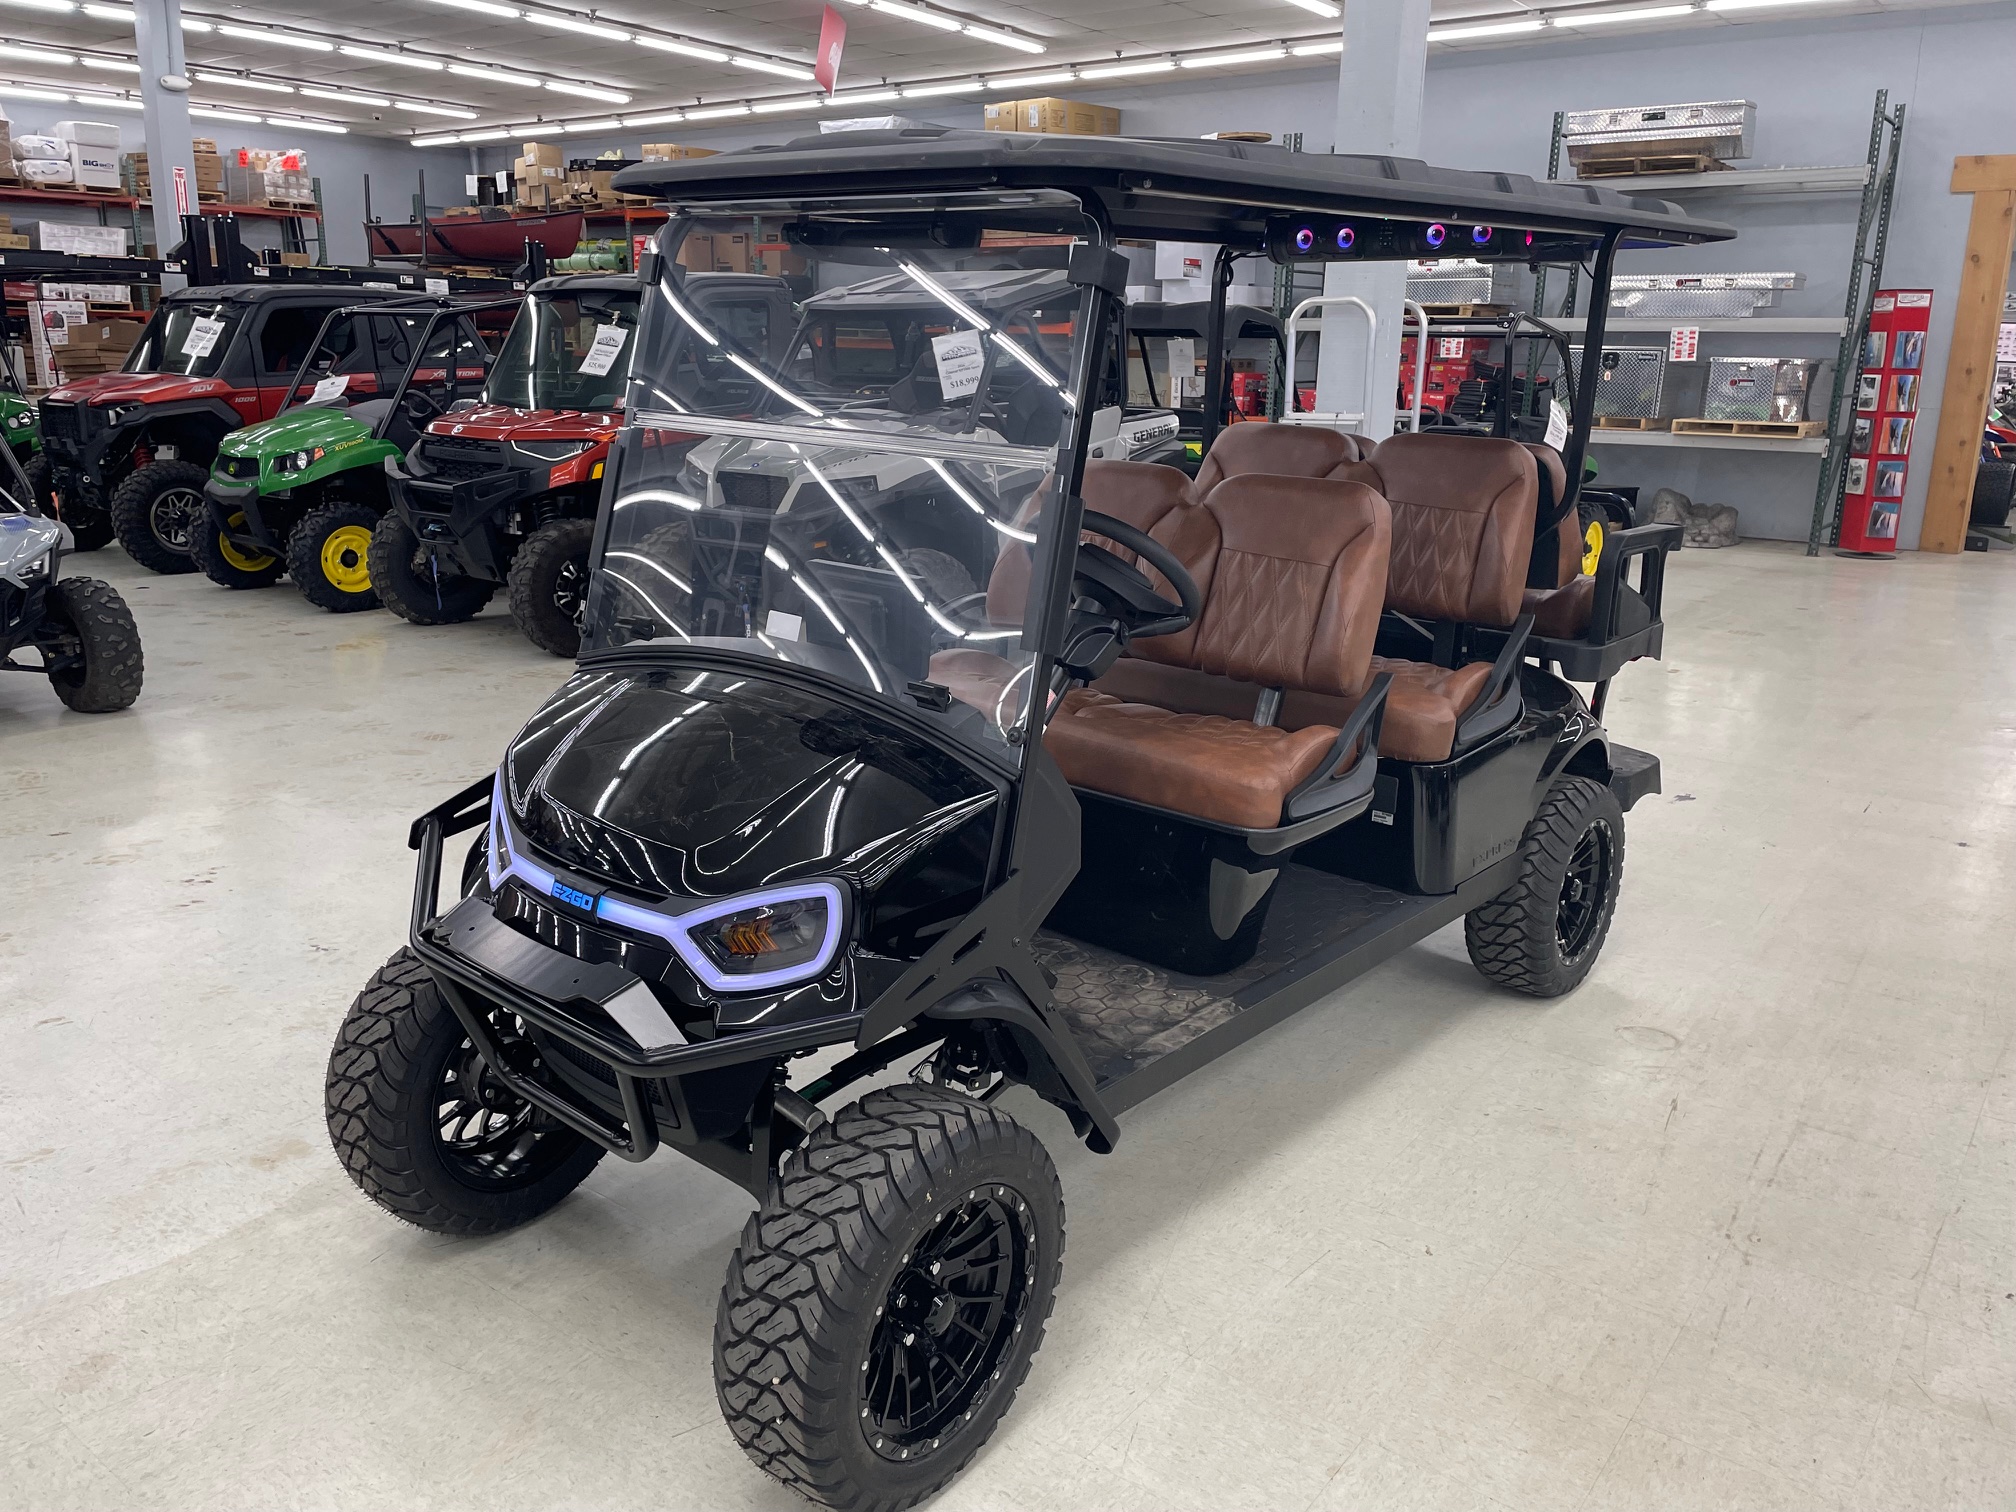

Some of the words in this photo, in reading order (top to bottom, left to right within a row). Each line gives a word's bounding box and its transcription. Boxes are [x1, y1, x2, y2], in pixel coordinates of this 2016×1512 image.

[82, 159, 99, 167] BIG
[188, 383, 215, 394] ADV
[950, 376, 979, 389] $18,999
[1133, 423, 1175, 442] GENERAL
[551, 881, 594, 911] EZGO
